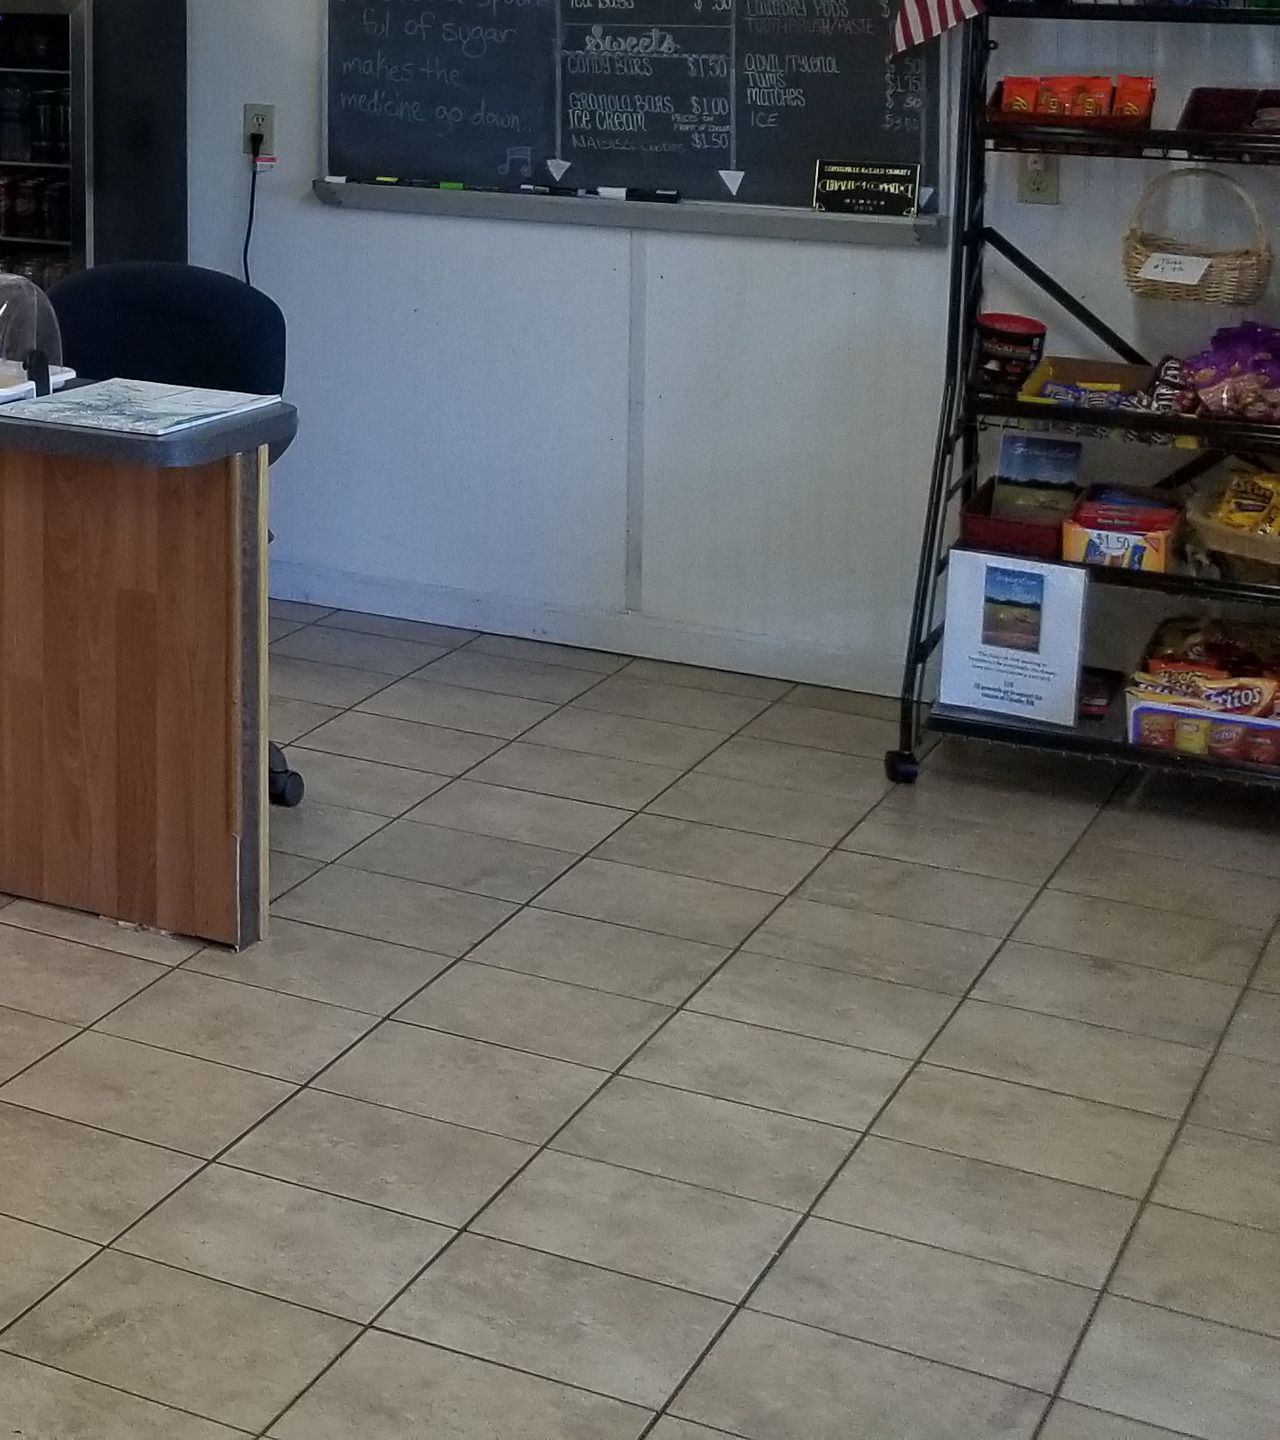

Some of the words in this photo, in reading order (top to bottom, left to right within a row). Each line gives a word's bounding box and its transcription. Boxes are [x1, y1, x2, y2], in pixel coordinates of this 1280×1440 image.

[404, 11, 436, 41] of
[442, 22, 518, 58] sugar
[585, 24, 677, 54] Sweets
[341, 50, 416, 83] makes
[417, 57, 463, 86] the
[340, 90, 427, 122] medicine
[435, 105, 463, 137] go
